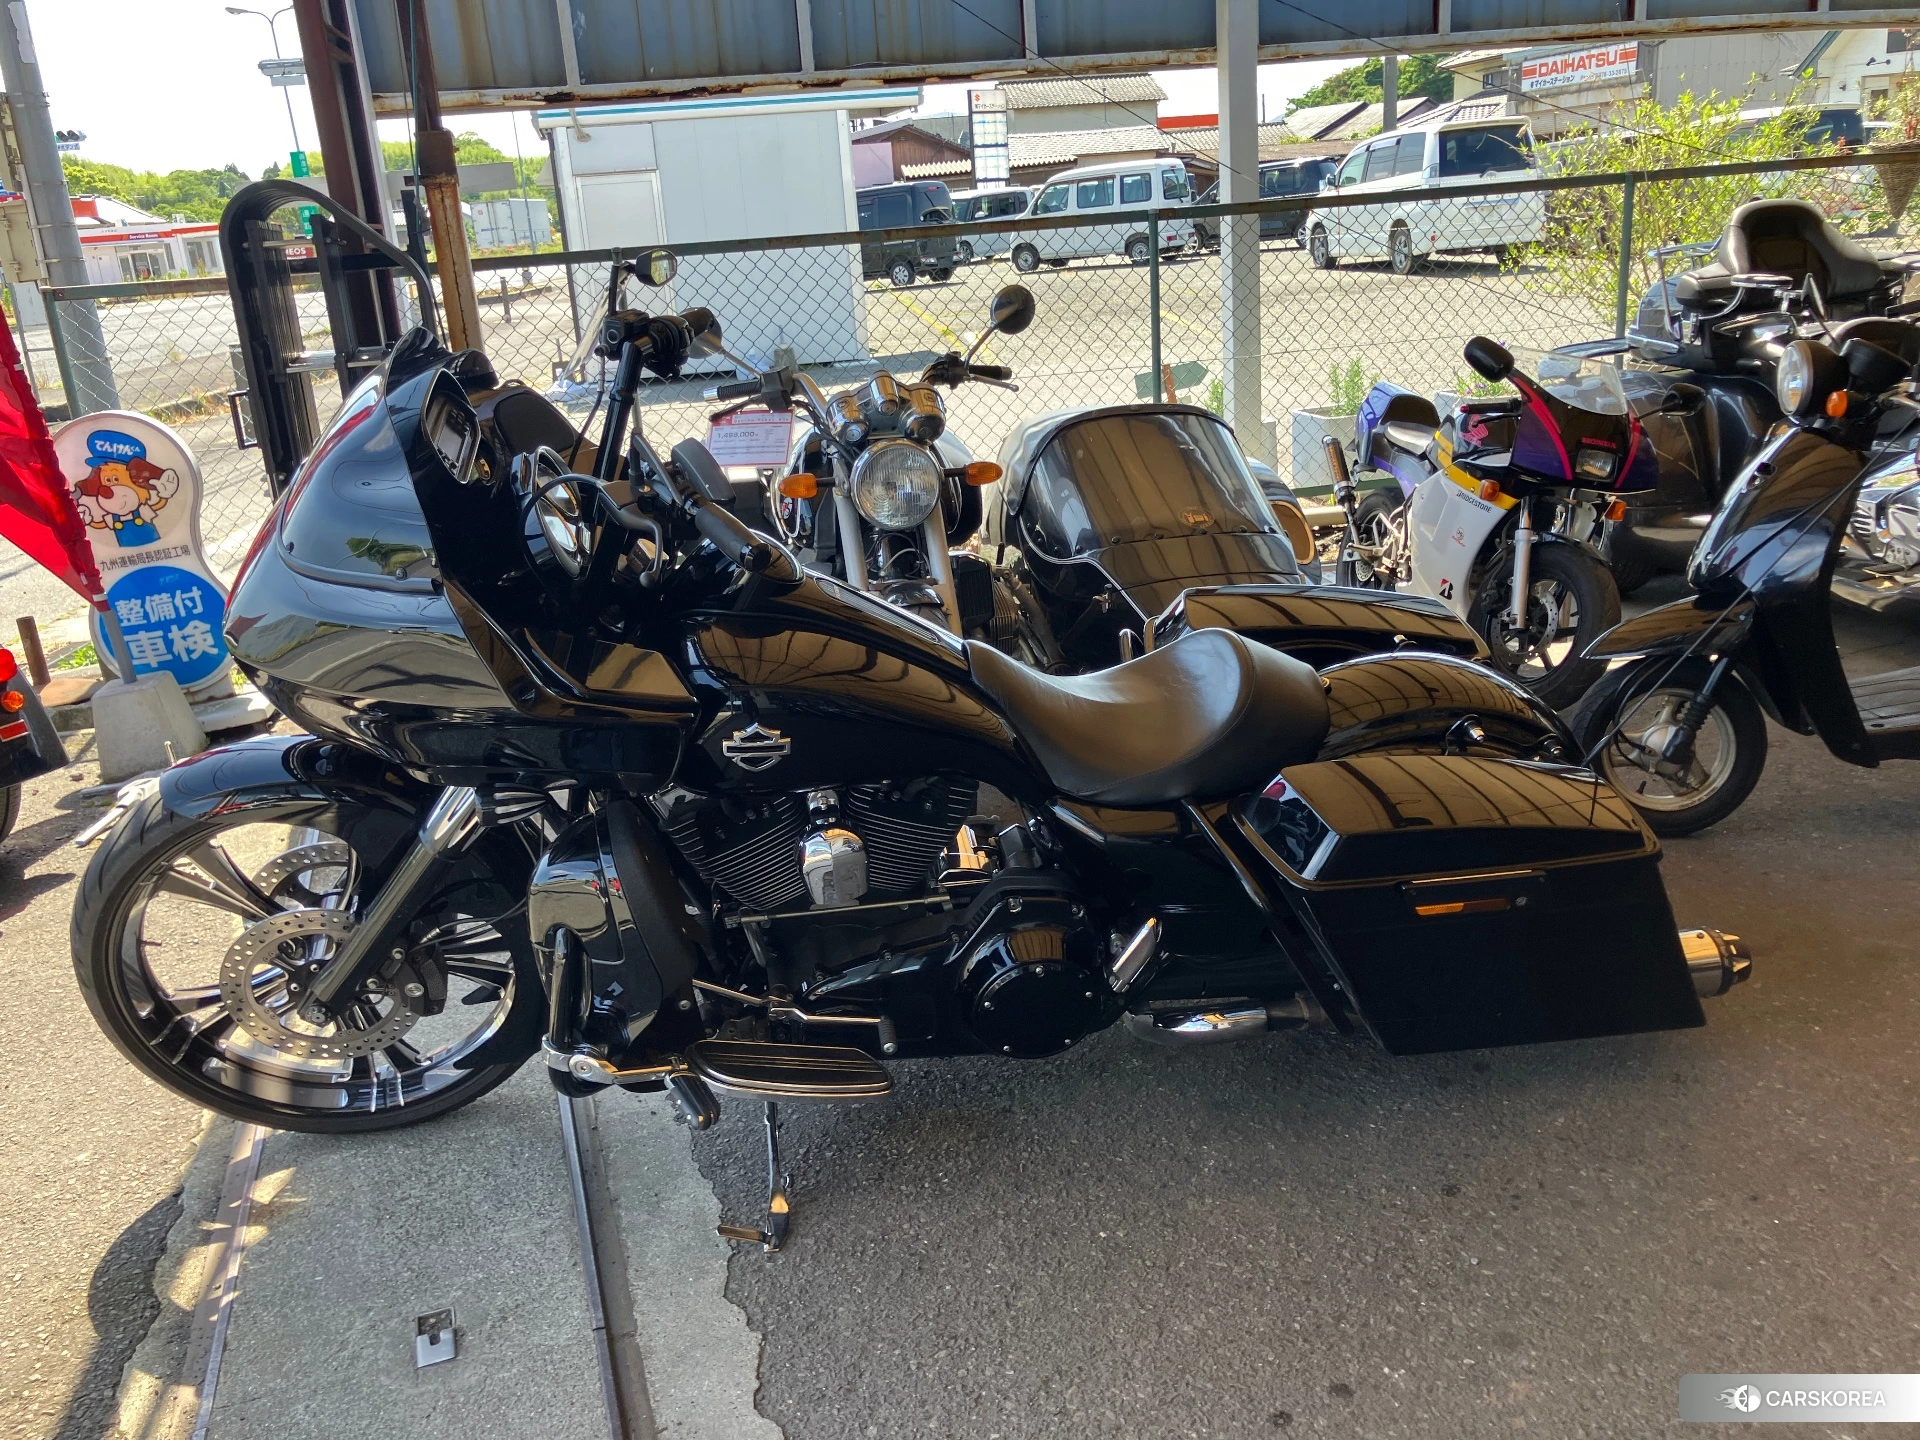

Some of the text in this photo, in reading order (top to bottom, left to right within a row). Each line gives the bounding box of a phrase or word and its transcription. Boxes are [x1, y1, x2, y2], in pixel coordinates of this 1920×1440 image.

[1538, 50, 1617, 77] DAIHATSU
[1582, 437, 1616, 449] HONDA
[1456, 489, 1492, 513] BRIDGESTONE
[100, 544, 191, 571] 九州運輸局長認証工場
[115, 585, 203, 627] 整備付
[124, 619, 218, 668] 車検
